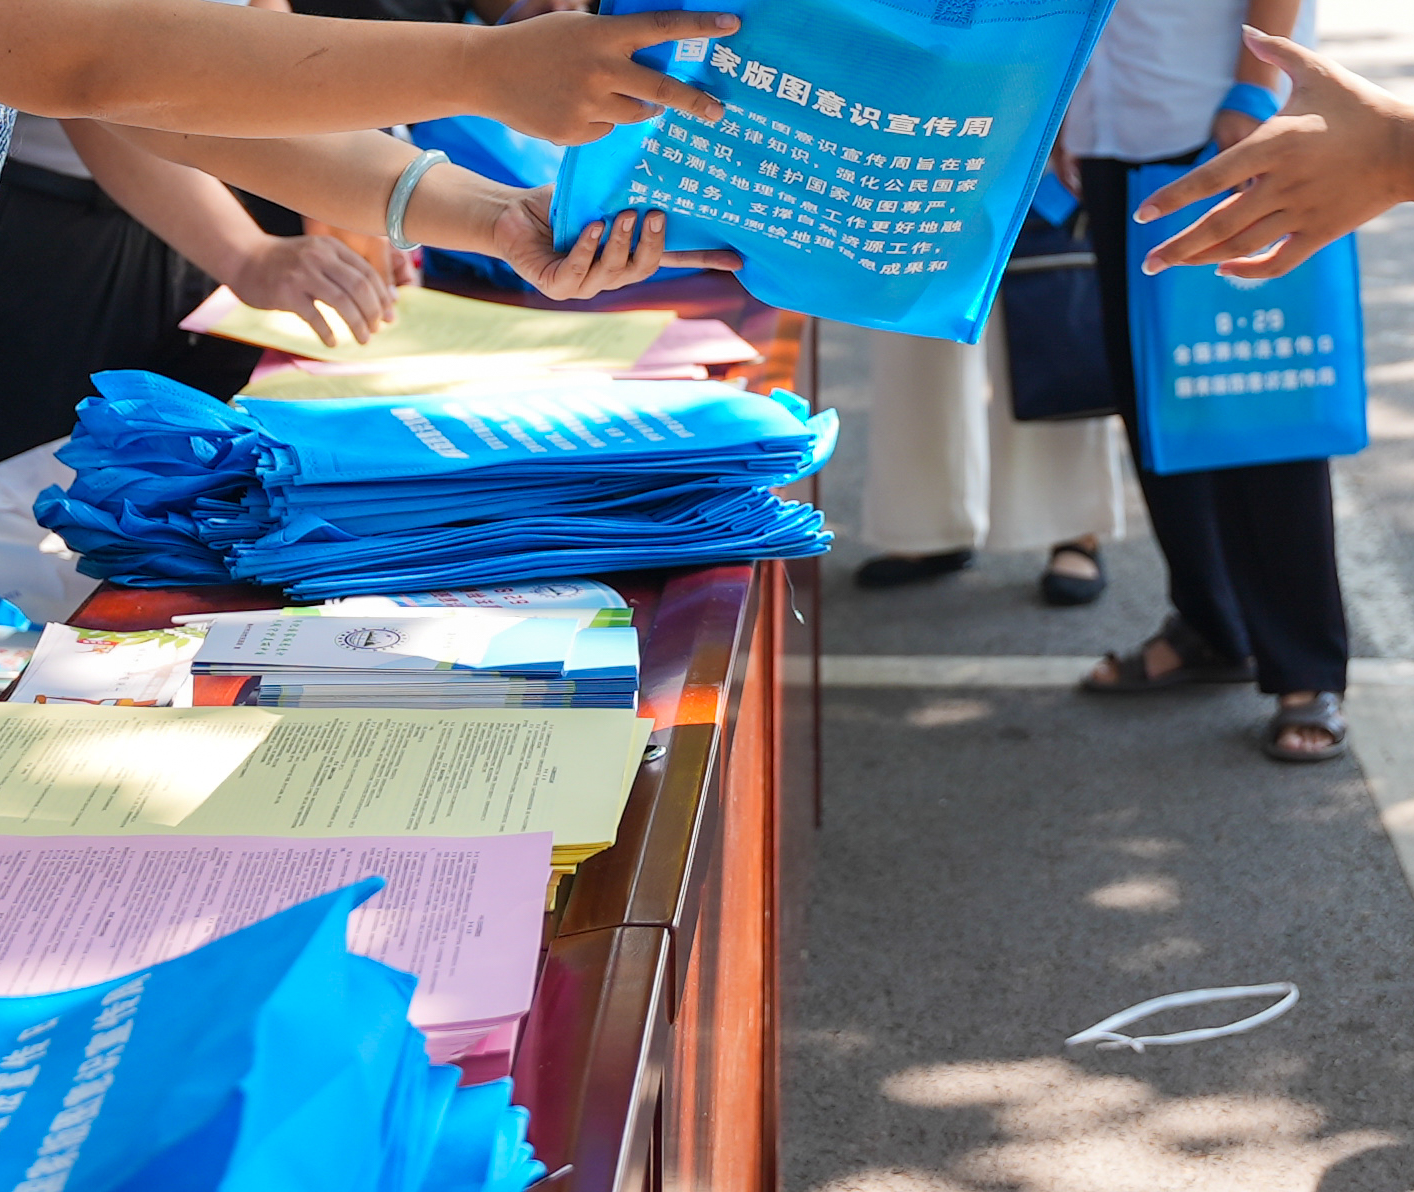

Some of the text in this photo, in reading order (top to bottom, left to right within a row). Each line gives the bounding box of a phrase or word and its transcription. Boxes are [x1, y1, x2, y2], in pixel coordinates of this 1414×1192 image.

[674, 37, 995, 139] 国家版图意识宣传周
[704, 92, 986, 172] 家版图意识宣传周旨在普
